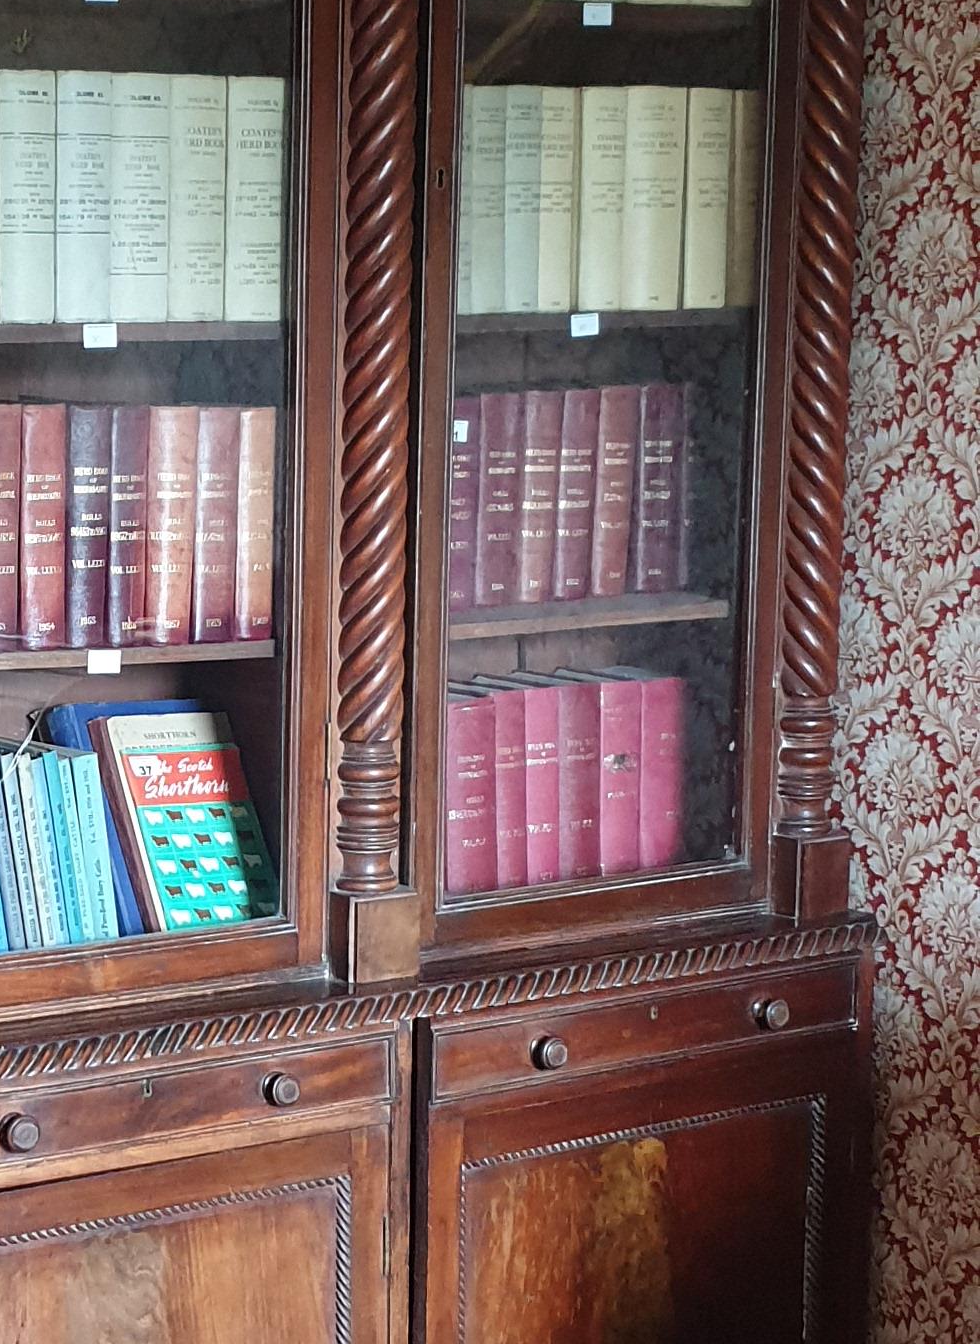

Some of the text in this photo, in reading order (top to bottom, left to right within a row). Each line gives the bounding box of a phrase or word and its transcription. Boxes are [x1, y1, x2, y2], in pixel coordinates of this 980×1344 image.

[143, 730, 197, 741] SHORTHORN
[177, 756, 214, 774] Scotch
[138, 766, 152, 776] 37
